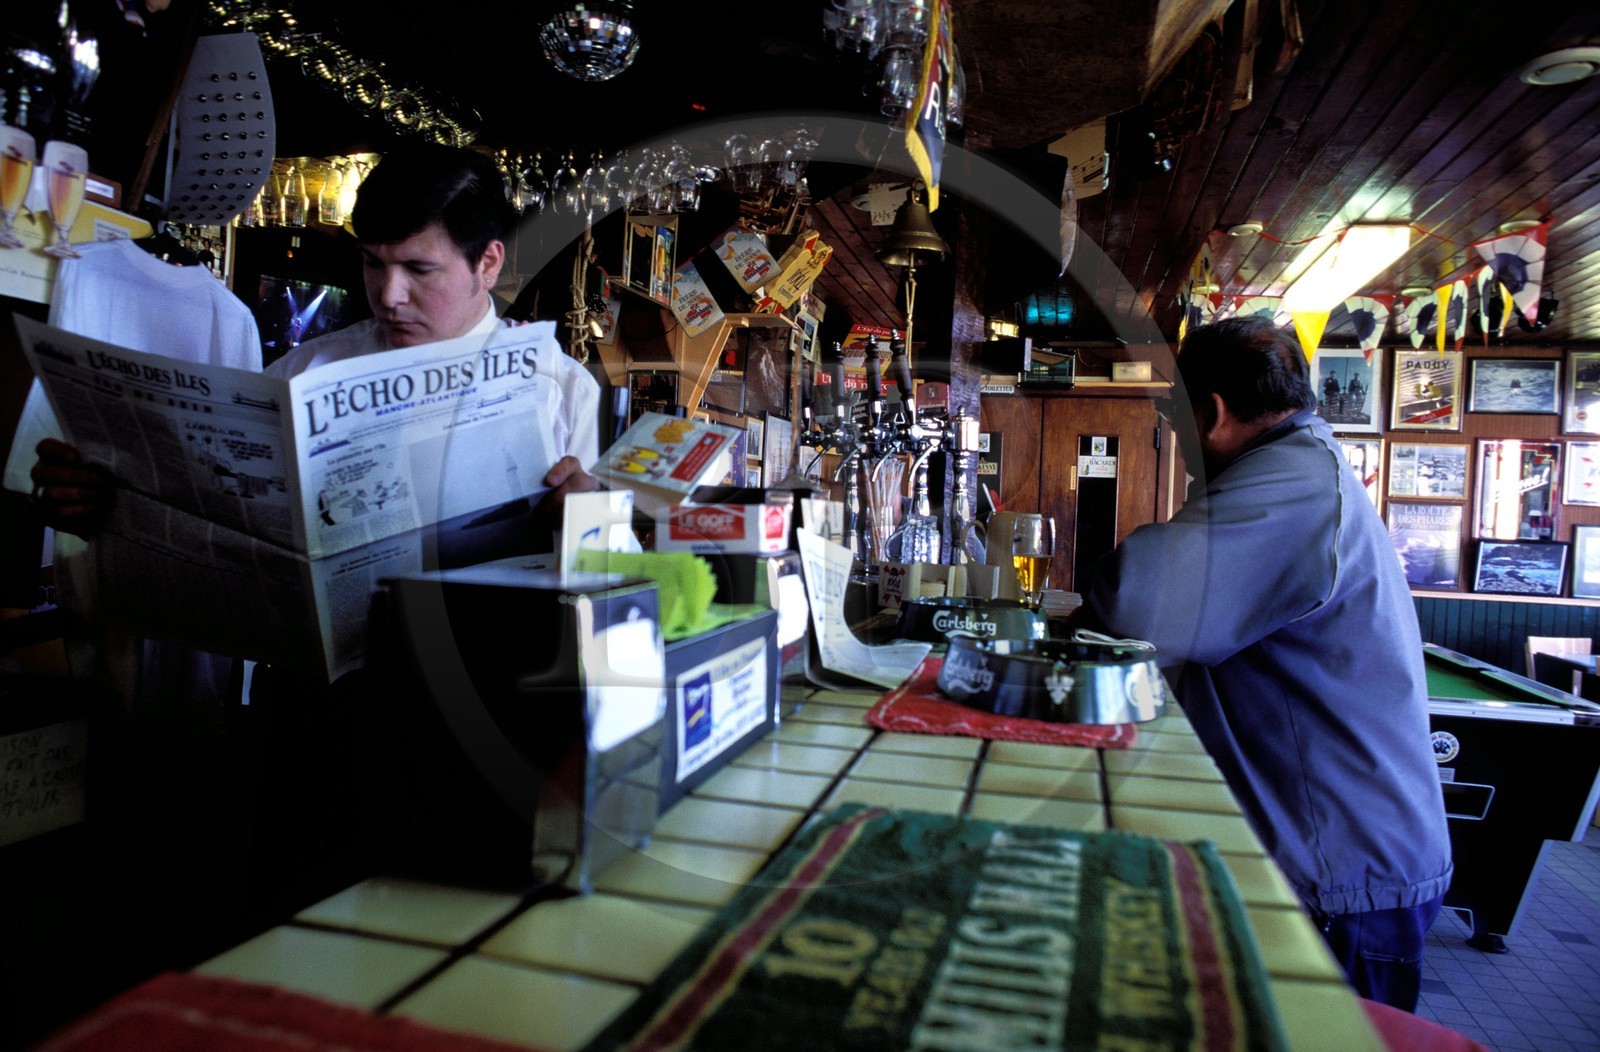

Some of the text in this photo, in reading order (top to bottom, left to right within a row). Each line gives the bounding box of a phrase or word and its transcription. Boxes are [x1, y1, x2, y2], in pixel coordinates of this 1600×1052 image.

[87, 350, 211, 397] L'ÉCHO DES ÎLES
[1406, 360, 1450, 369] PADDY
[304, 374, 415, 438] L'ÉCHO
[422, 361, 476, 395] DES
[482, 347, 539, 382] ÎLES
[932, 610, 997, 638] Carlsberg
[764, 917, 878, 986] 10
